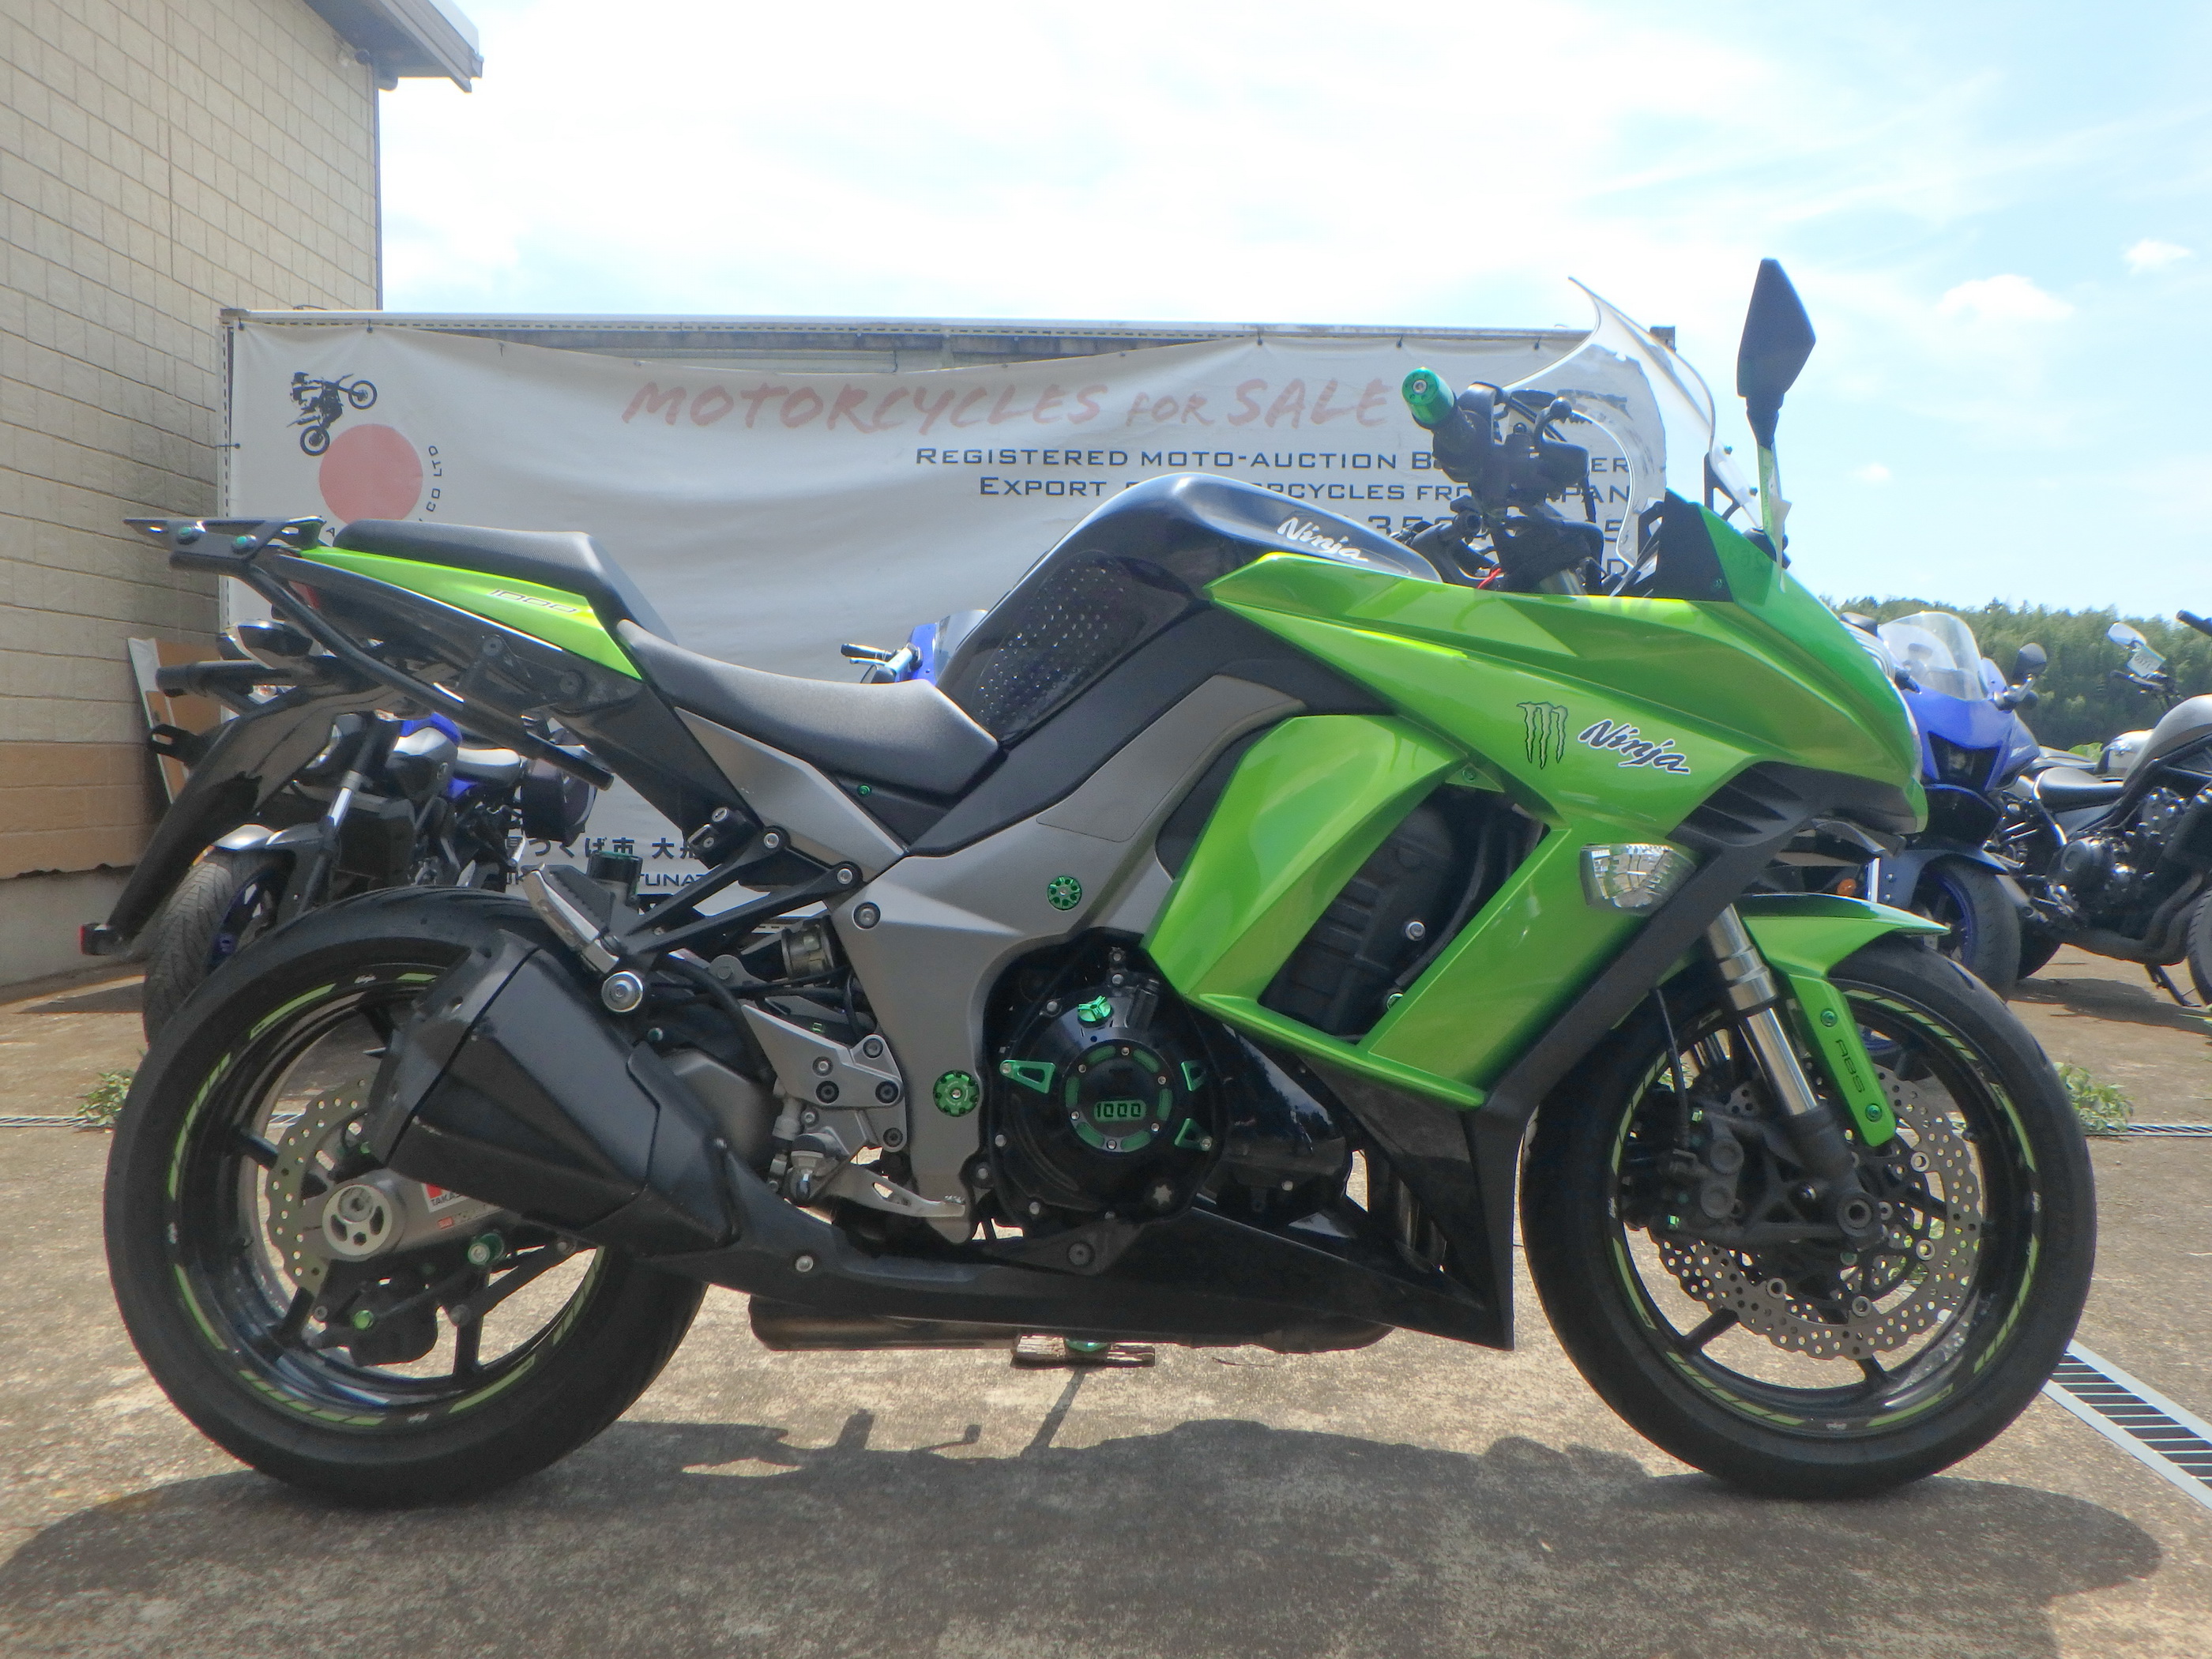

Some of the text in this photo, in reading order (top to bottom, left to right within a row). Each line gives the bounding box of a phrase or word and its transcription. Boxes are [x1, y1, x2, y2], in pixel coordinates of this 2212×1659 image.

[621, 378, 1394, 434] MOTORCYCLES FOR SALE
[426, 446, 442, 512] CO LTD
[916, 448, 1127, 466] REGISTERED
[1141, 451, 1397, 469] MOTO-AUCTION
[980, 477, 1107, 496] EXPORT
[1277, 517, 1368, 562] Ninja
[490, 589, 577, 613] 1000
[1578, 719, 1691, 775] Ninja
[1835, 1039, 1865, 1093] ABS
[1096, 1103, 1141, 1118] 1000
